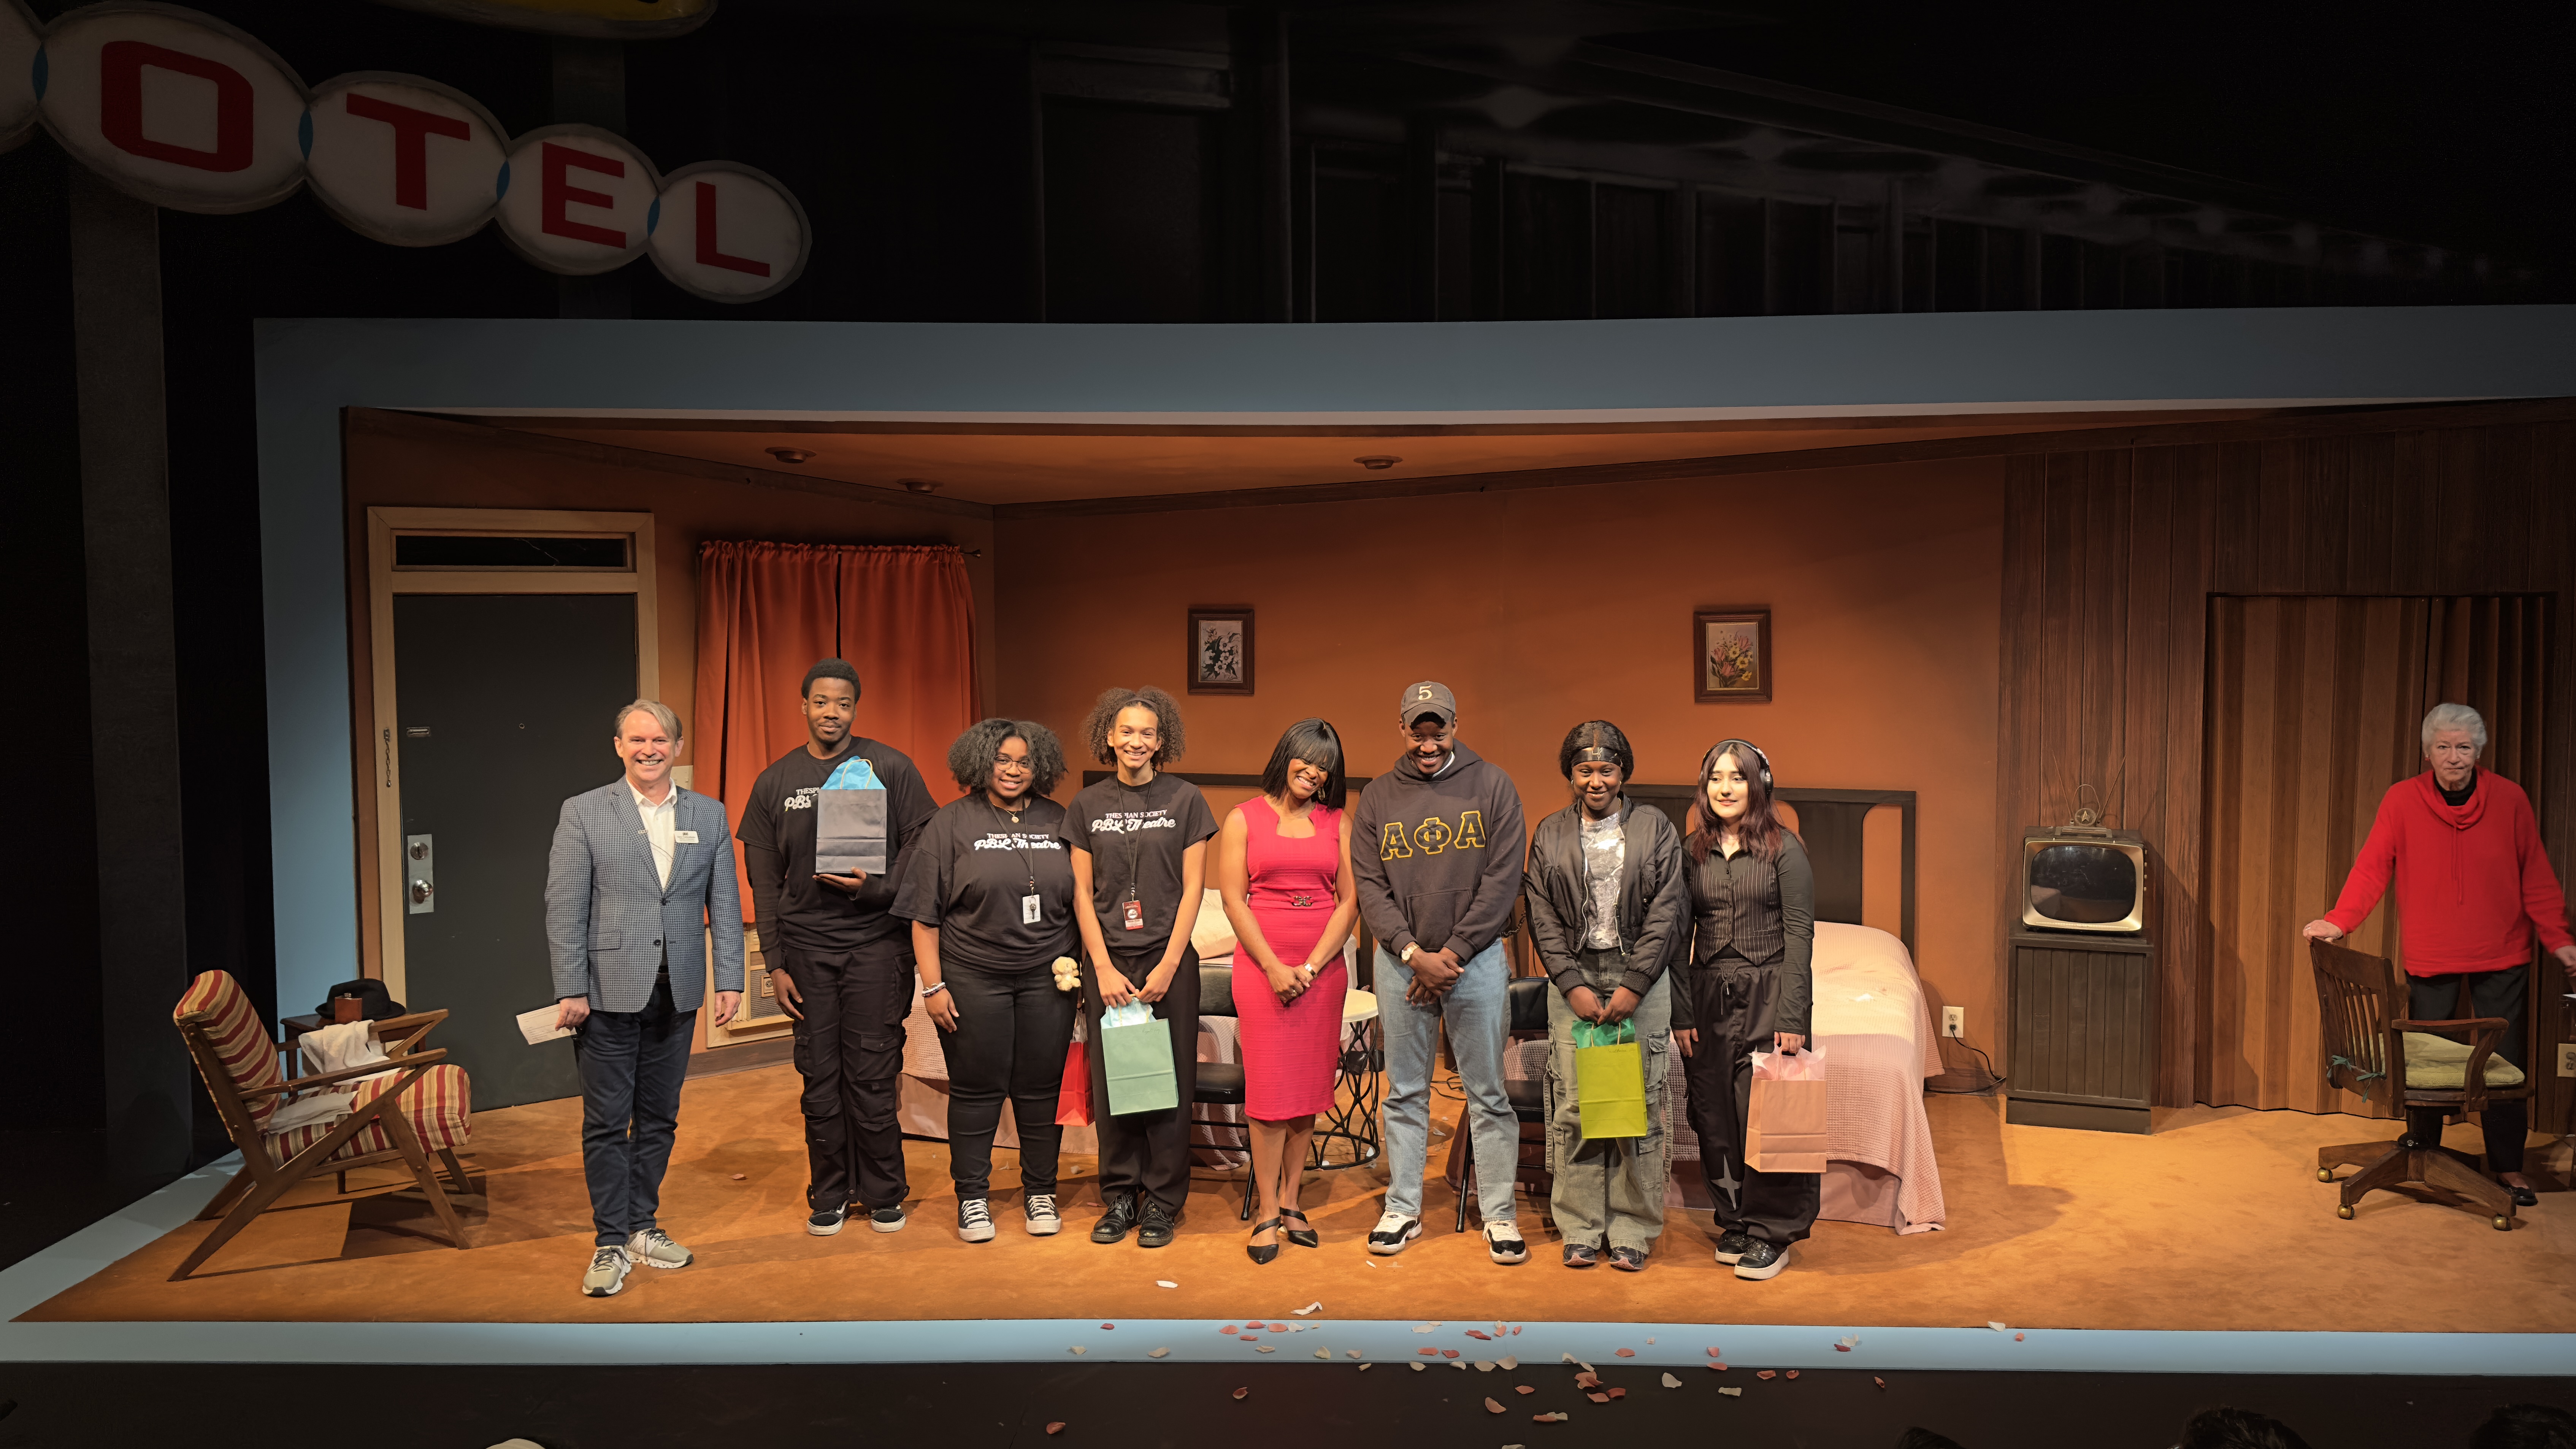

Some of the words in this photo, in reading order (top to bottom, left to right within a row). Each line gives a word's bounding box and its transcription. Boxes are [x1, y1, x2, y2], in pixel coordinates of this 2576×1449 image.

[100, 40, 770, 278] OTEL
[1418, 685, 1432, 700] 5
[974, 838, 1012, 850] PBL
